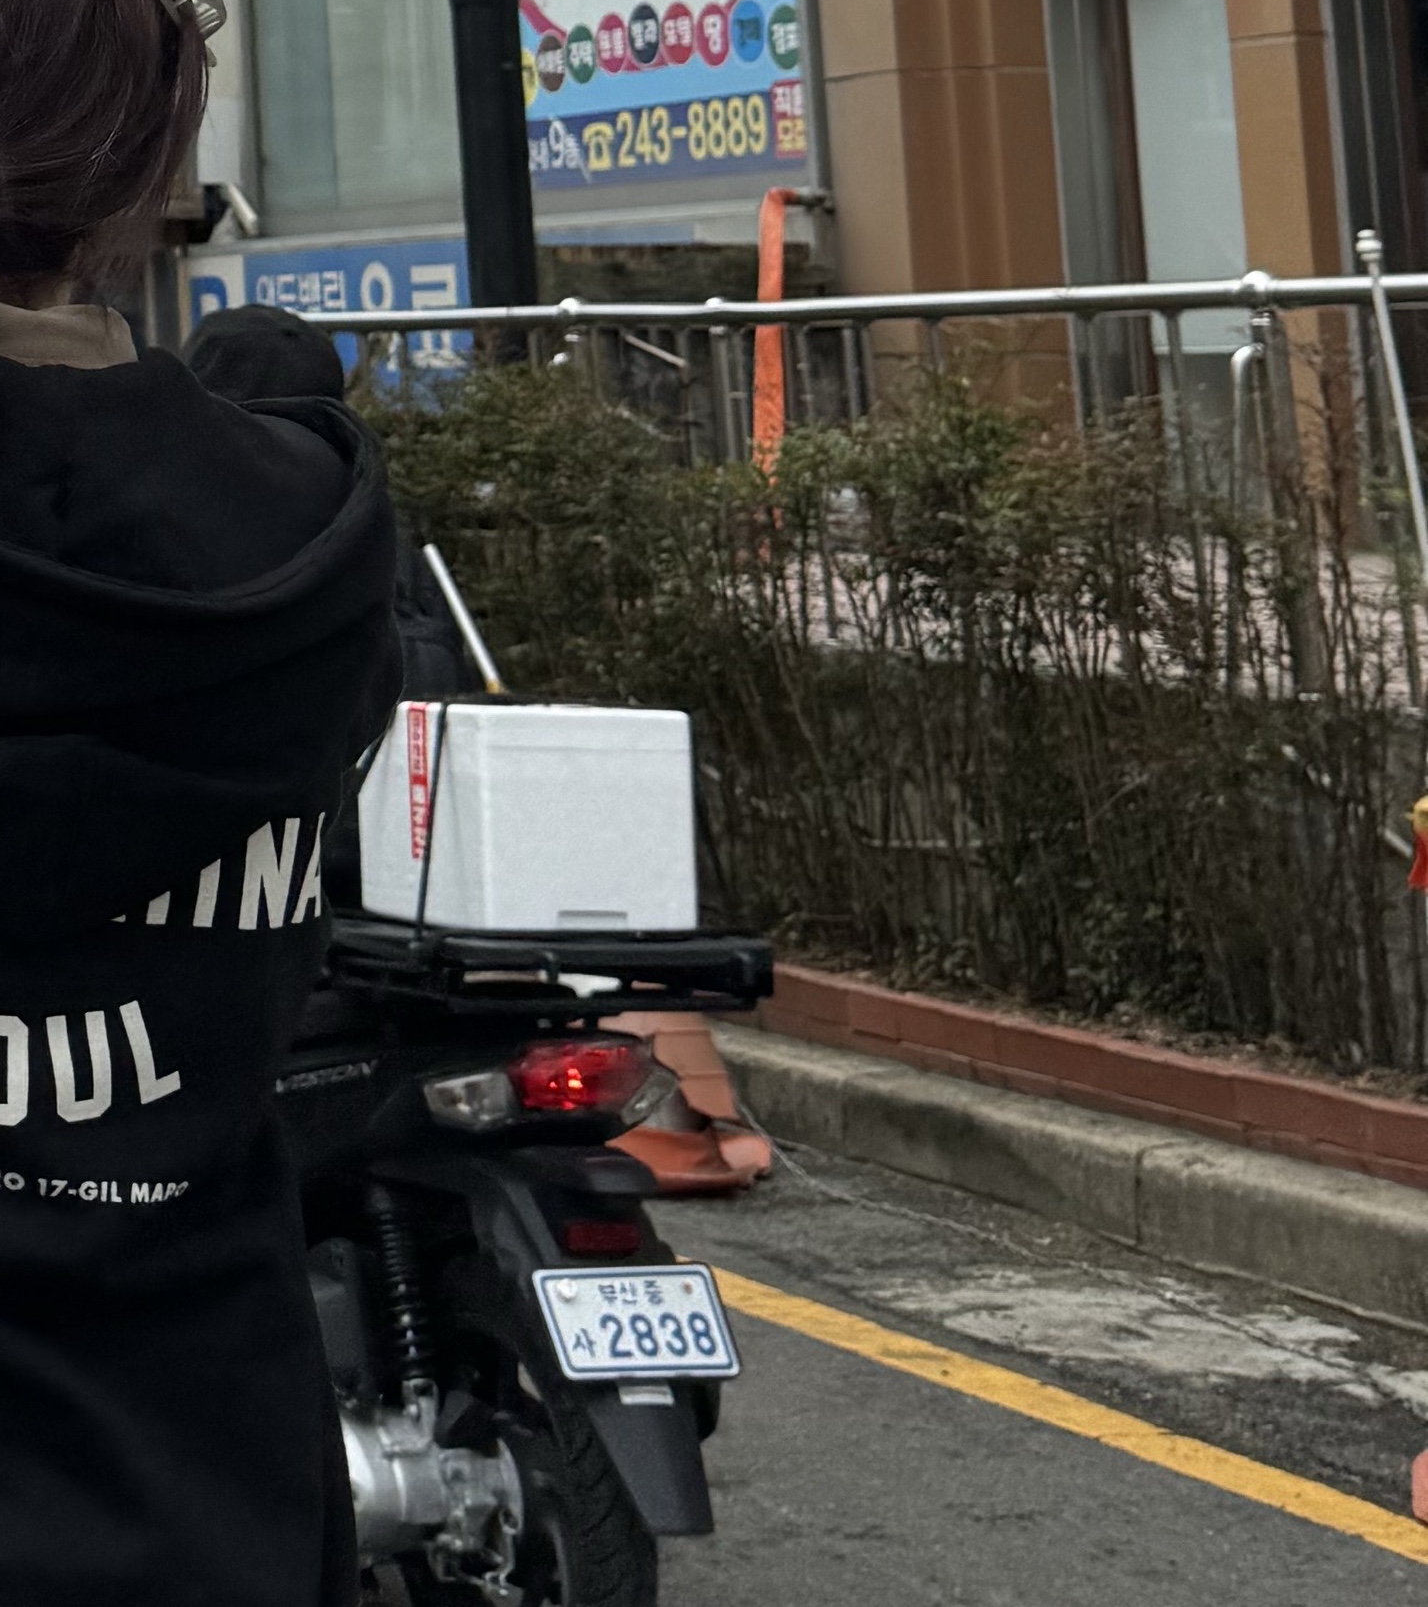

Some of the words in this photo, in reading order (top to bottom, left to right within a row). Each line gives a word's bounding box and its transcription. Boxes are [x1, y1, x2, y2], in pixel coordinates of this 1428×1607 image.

[614, 95, 767, 169] 243-8889
[38, 1178, 122, 1204] 17-GIL
[599, 1282, 639, 1305] 부산
[644, 1280, 663, 1305] 중
[573, 1328, 595, 1356] 사
[600, 1311, 716, 1357] 2838
